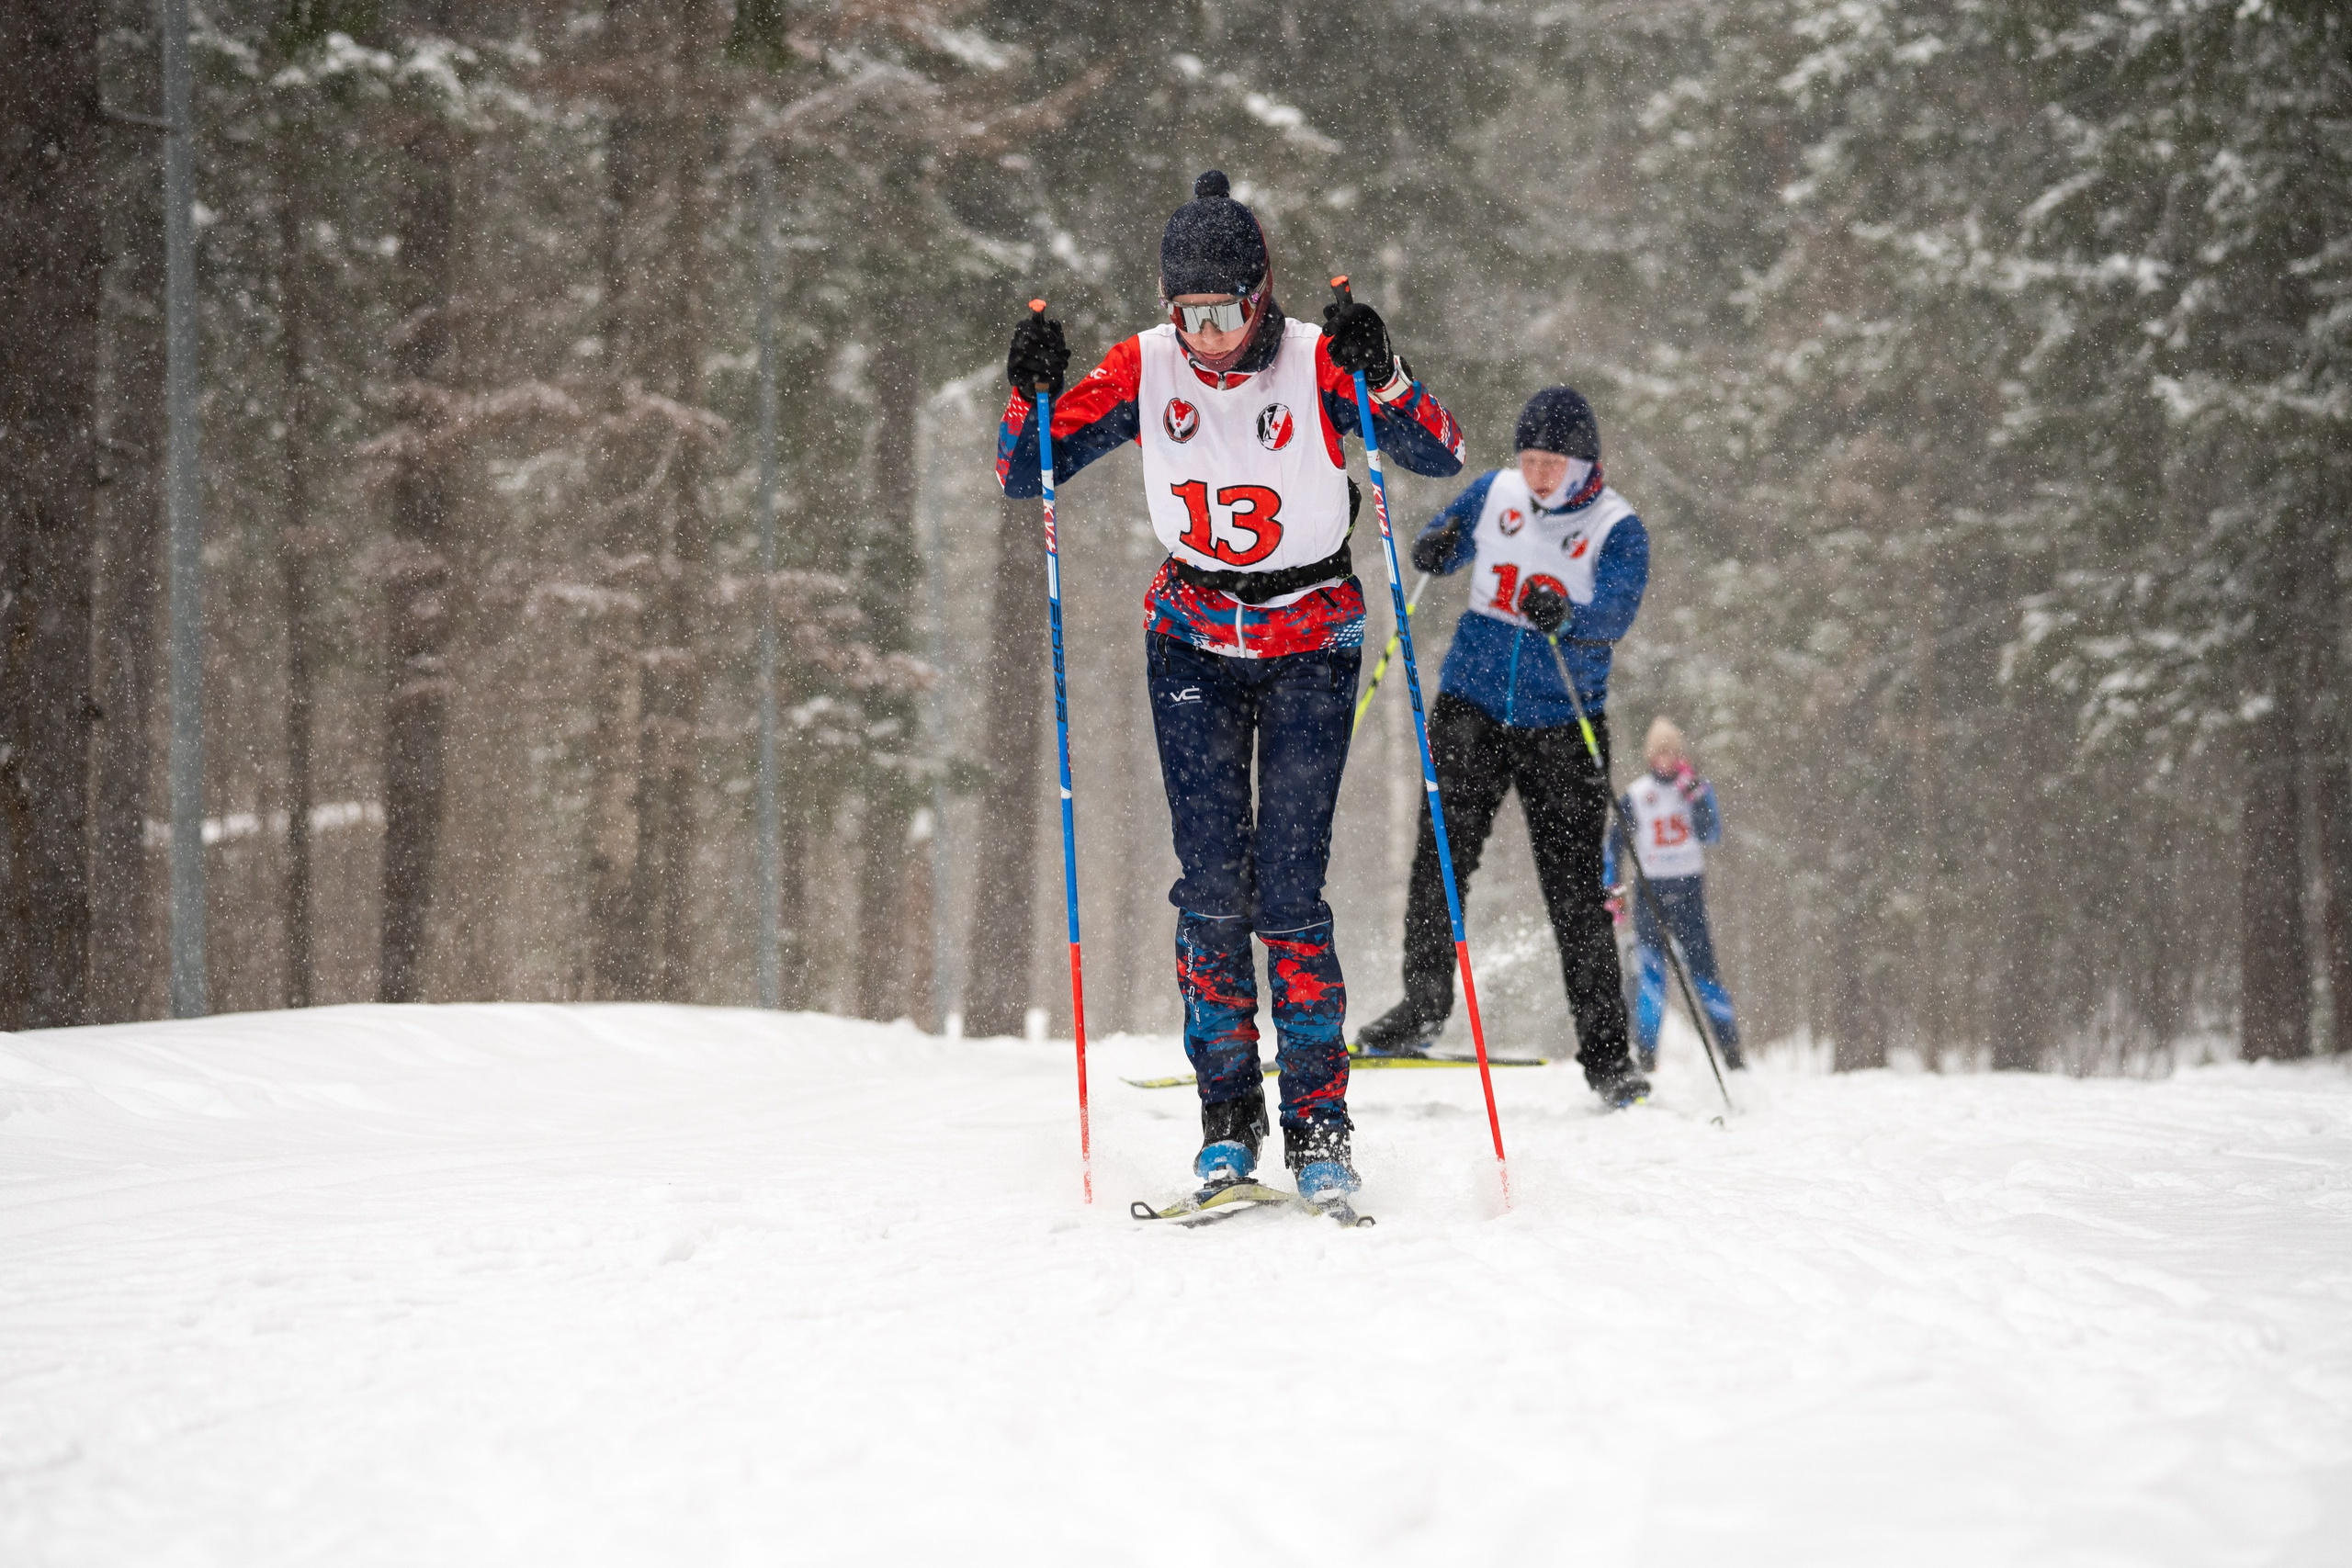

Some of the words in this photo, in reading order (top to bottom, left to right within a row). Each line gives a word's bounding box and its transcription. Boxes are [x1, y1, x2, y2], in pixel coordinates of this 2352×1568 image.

[1170, 479, 1283, 567] 13
[1371, 482, 1389, 536] KV+
[1050, 601, 1066, 724] FORZA
[1390, 586, 1422, 714] FORZA
[1654, 814, 1688, 847] 15
